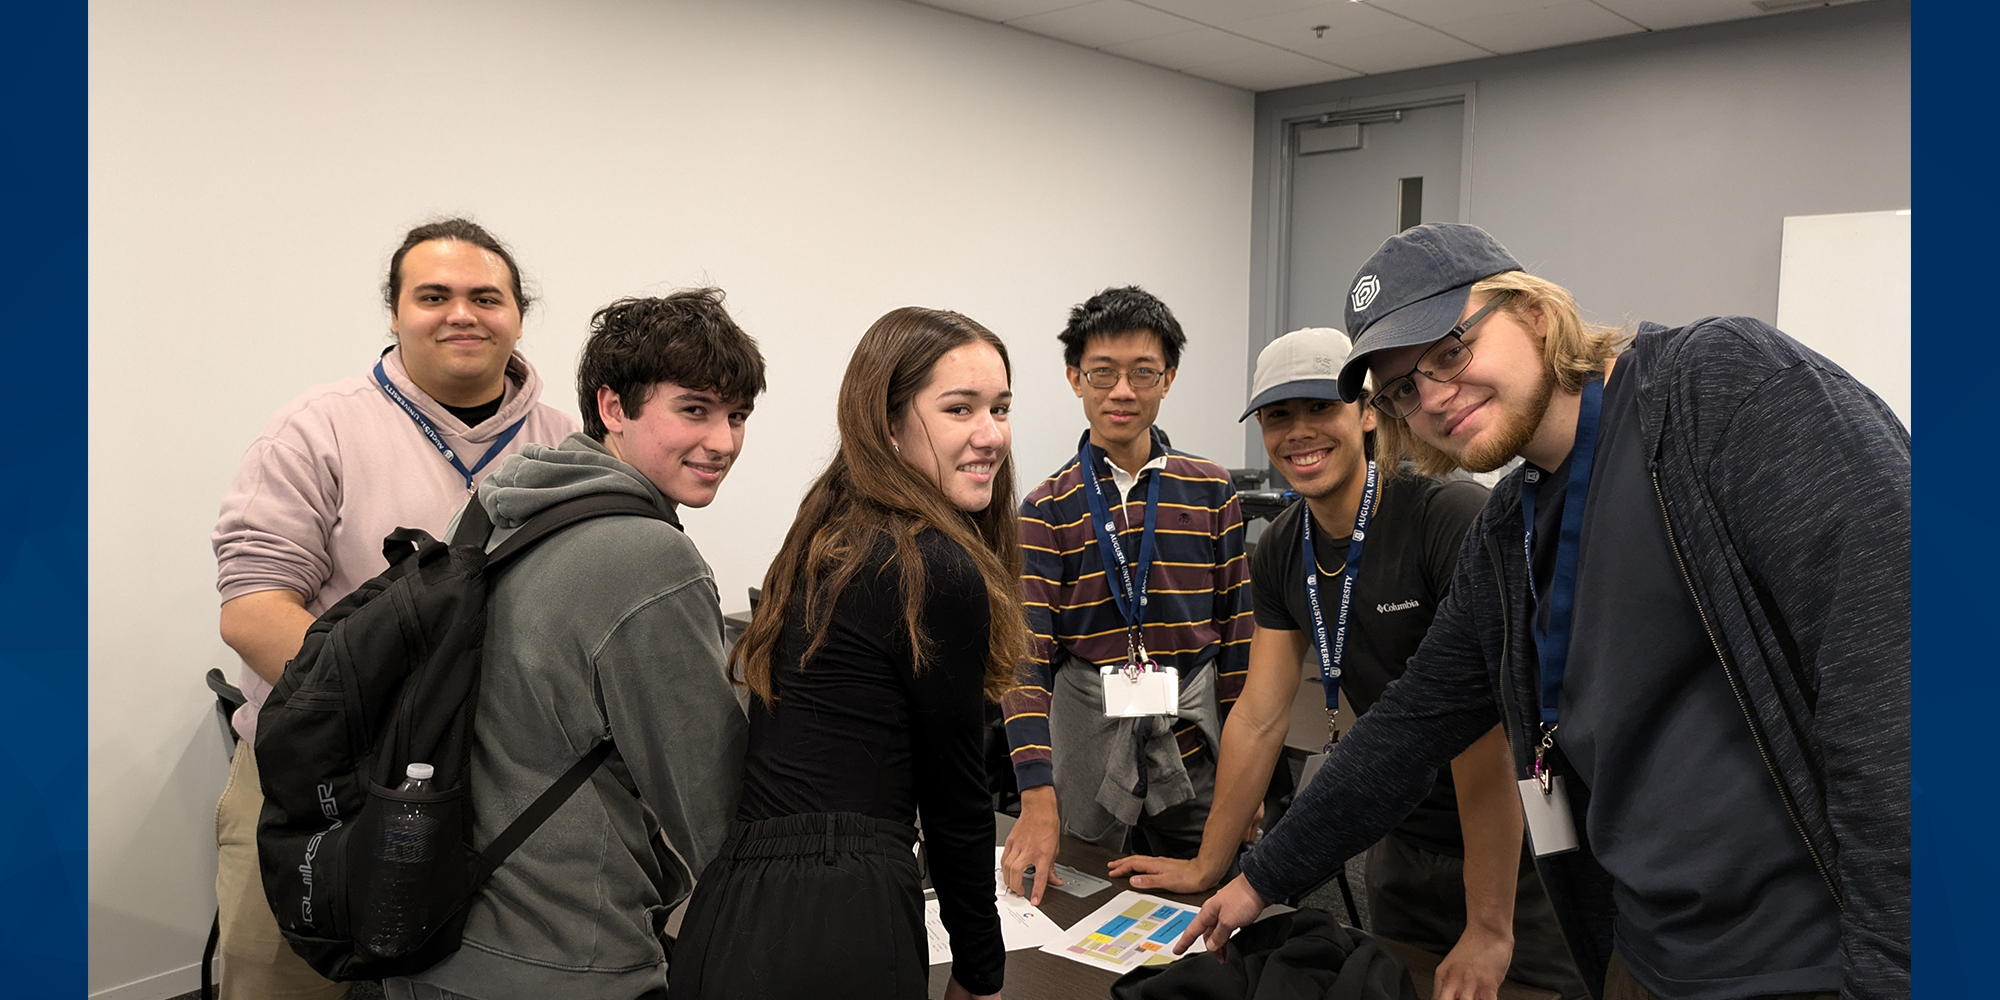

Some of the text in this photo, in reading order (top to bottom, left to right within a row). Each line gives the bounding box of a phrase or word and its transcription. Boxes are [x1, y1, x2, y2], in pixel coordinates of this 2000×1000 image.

[383, 383, 421, 421] UNIVERSITY
[1357, 460, 1376, 529] AUGUSTA UNIVER
[1109, 533, 1134, 602] AUGUSTA UNIVERSI
[1309, 587, 1331, 677] AUGUSTA UNIVERSI
[1333, 574, 1354, 665] AUGUSTA UNIVERSITY
[1383, 599, 1420, 613] Columbia
